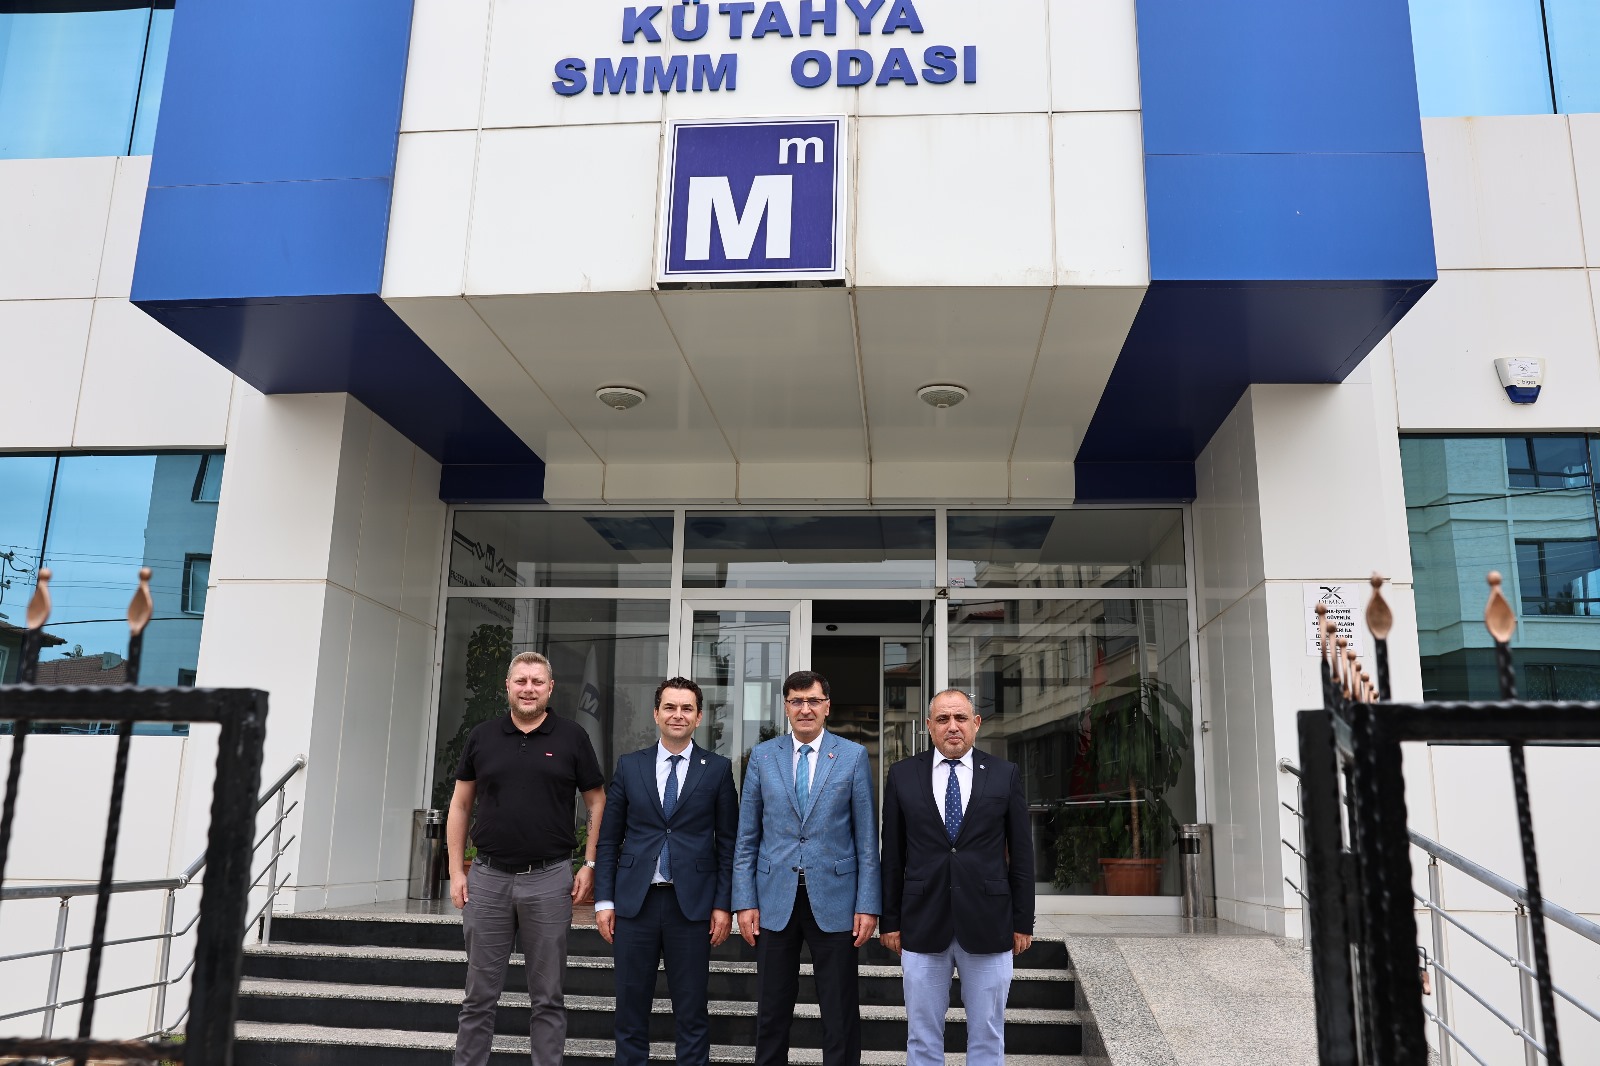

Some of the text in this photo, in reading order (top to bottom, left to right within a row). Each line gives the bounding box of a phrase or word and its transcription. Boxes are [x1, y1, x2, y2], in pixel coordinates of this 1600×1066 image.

[622, 0, 924, 43] KÜTAHYA
[552, 45, 977, 96] SMMM ODASI
[778, 135, 824, 165] m
[684, 174, 793, 261] M
[937, 588, 948, 597] 4
